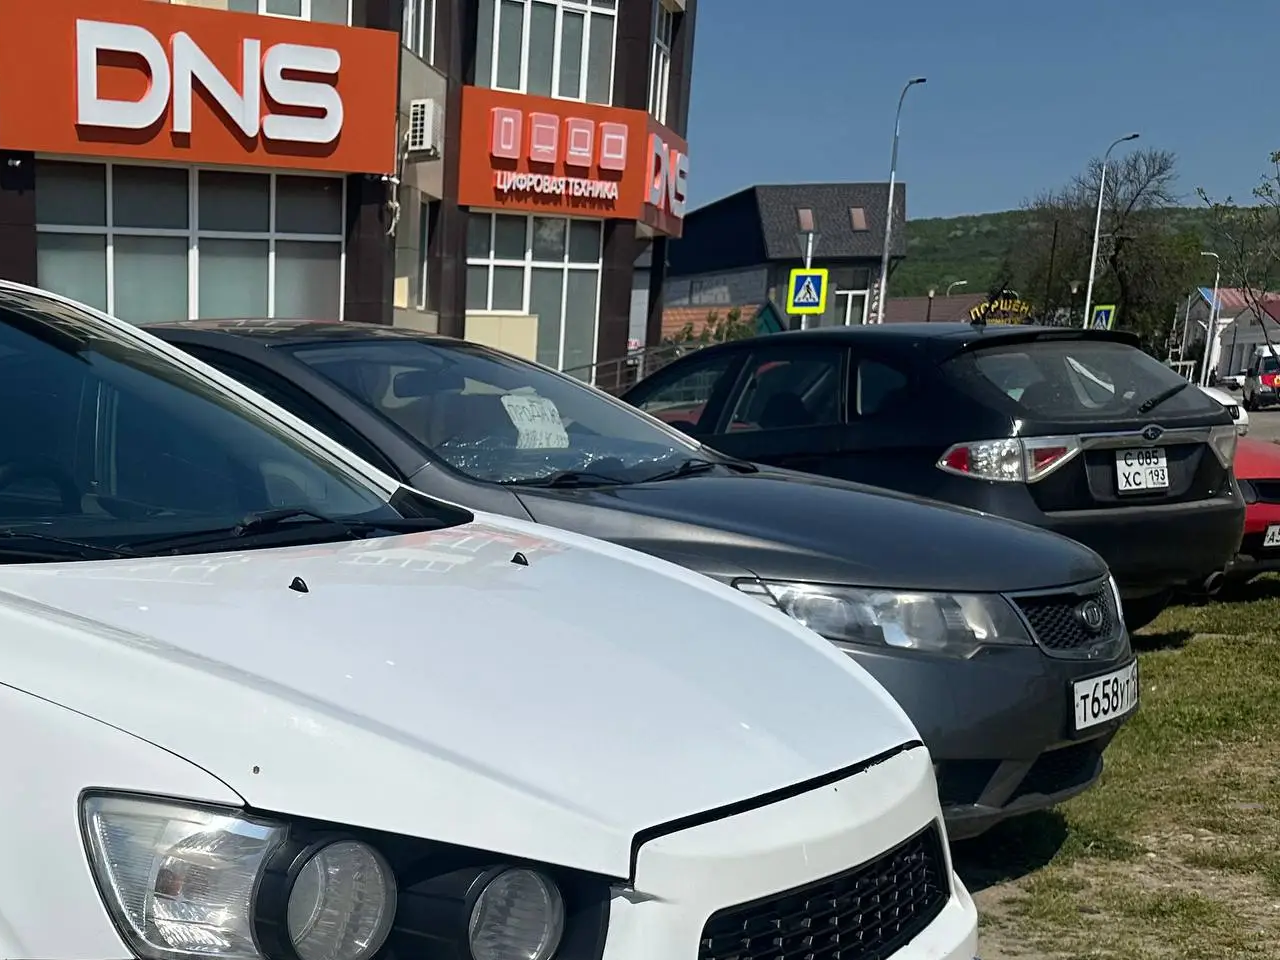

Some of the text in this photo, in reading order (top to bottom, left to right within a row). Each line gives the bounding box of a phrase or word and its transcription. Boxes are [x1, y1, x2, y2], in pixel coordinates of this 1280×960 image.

[76, 18, 344, 144] DNS
[495, 171, 619, 201] ЦИФРОВАЯ ТЕХНИКА
[1124, 450, 1159, 467] С 085
[1123, 469, 1166, 488] ХС 193
